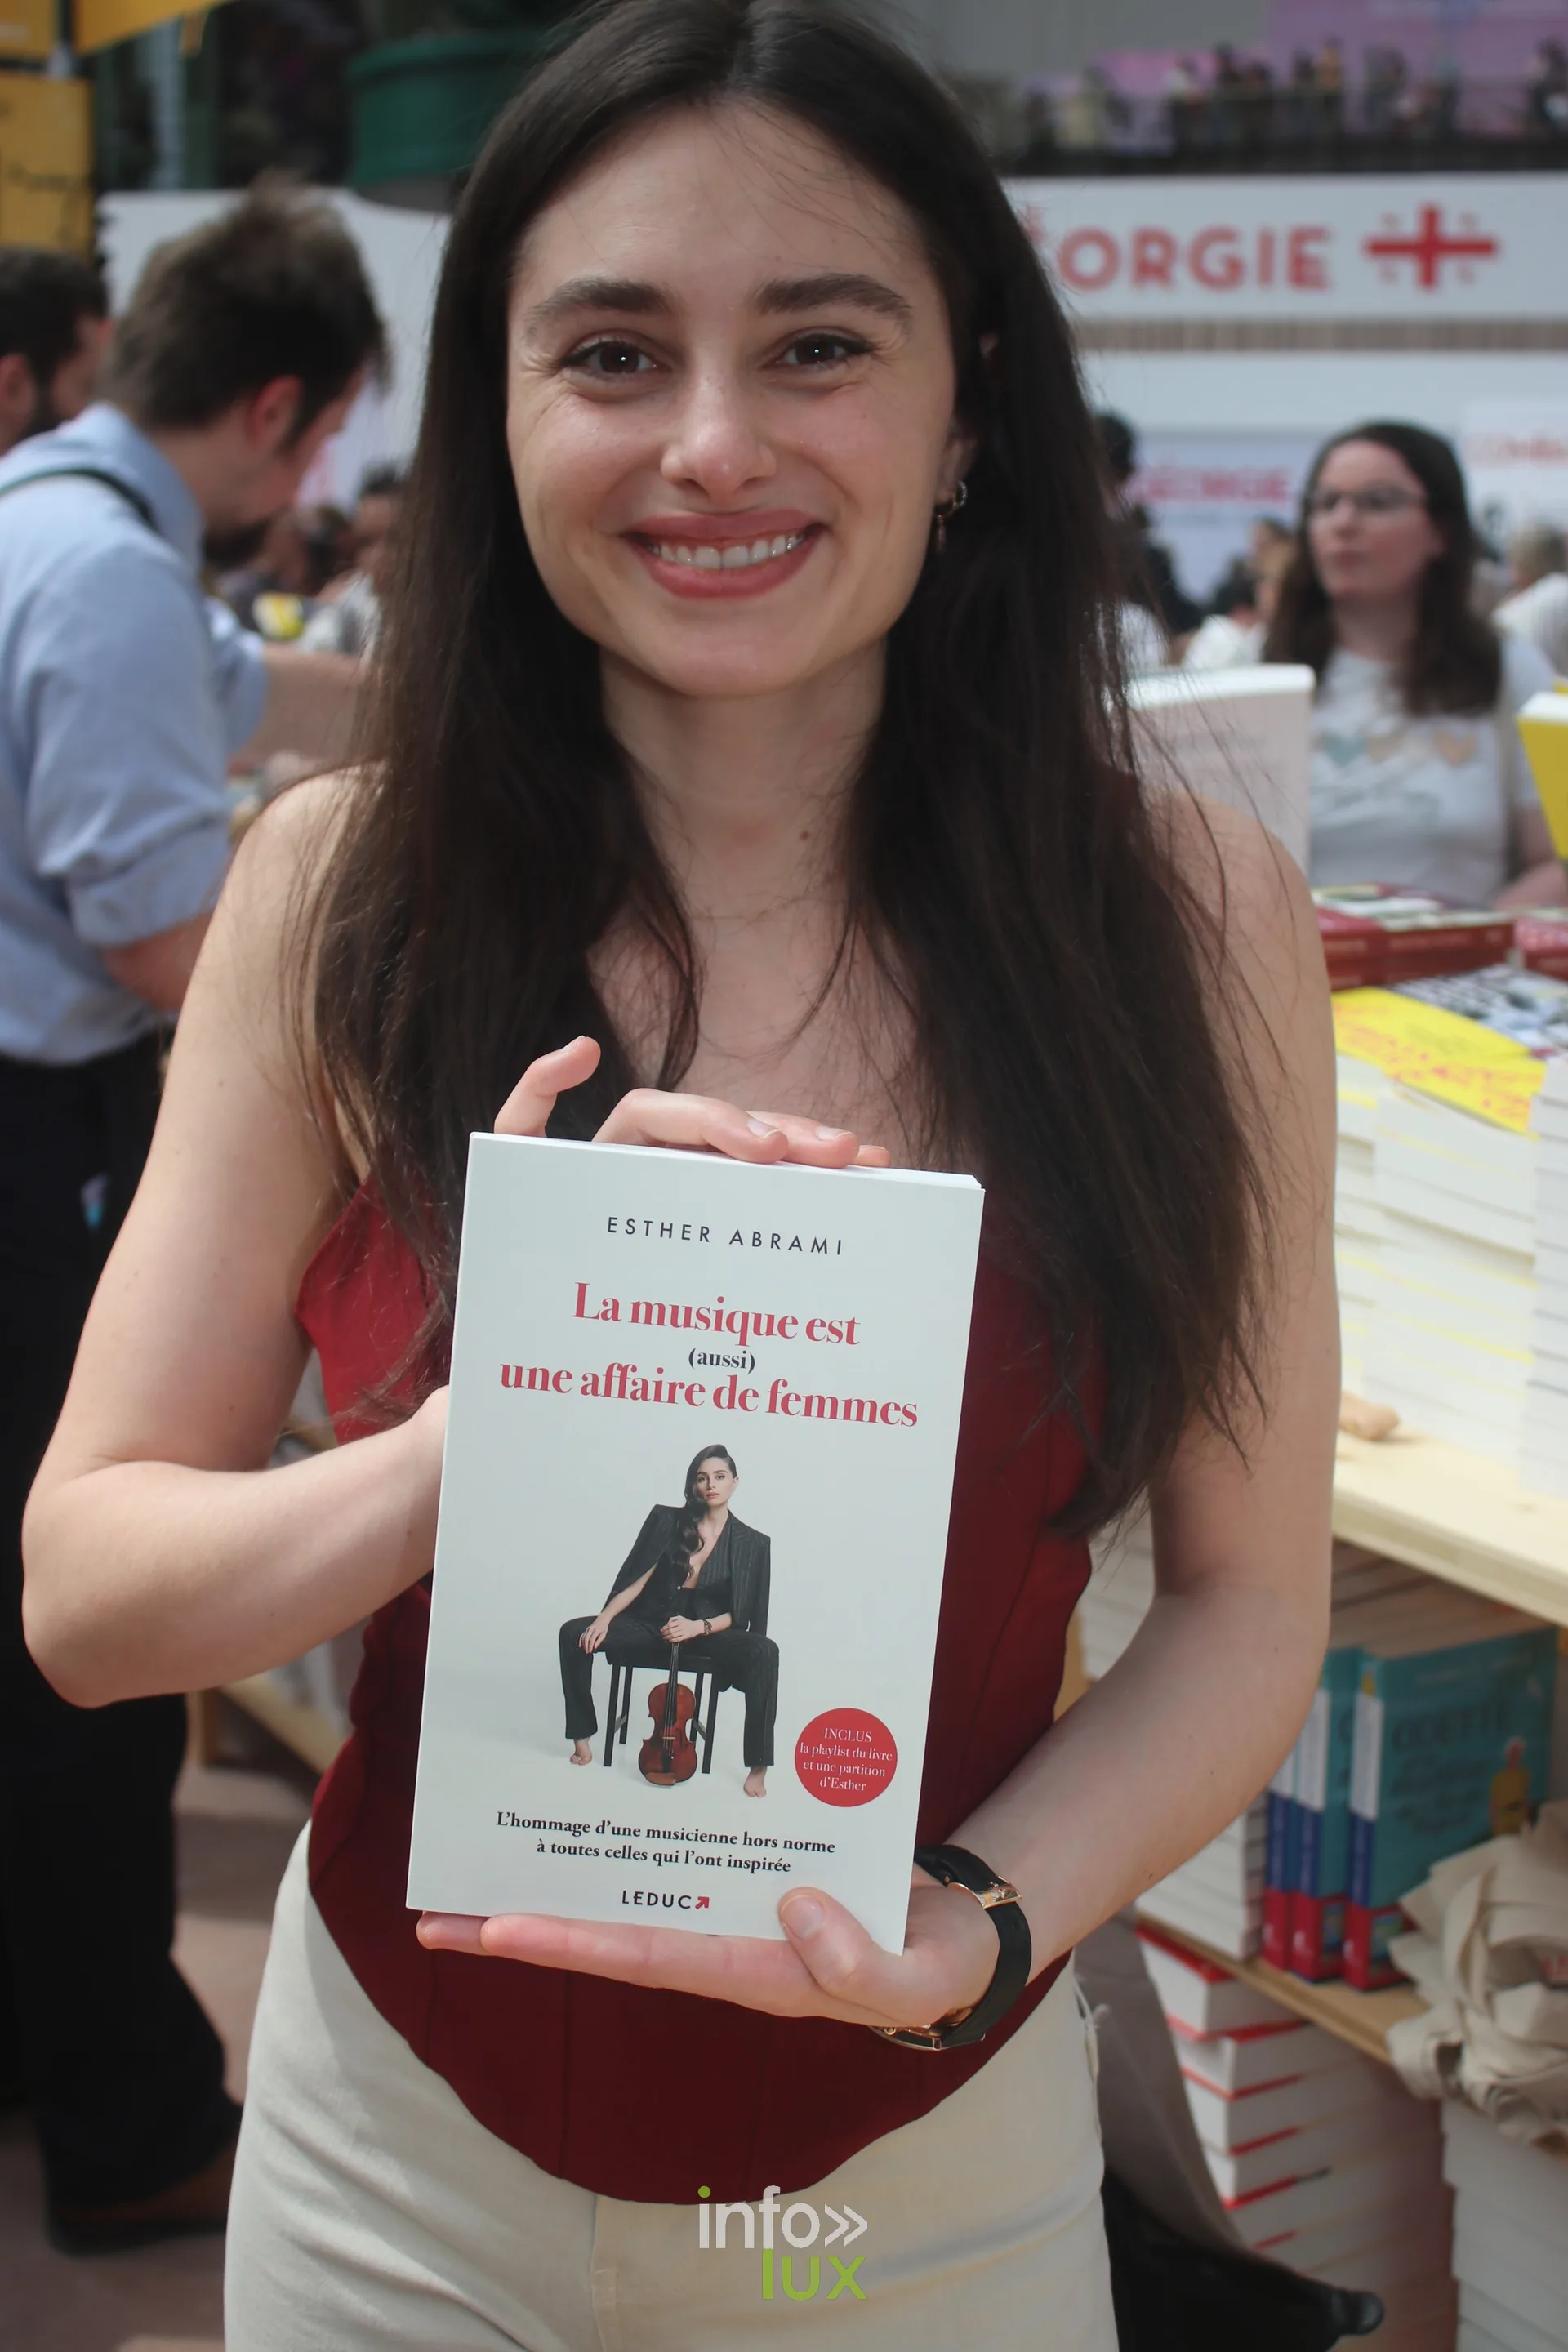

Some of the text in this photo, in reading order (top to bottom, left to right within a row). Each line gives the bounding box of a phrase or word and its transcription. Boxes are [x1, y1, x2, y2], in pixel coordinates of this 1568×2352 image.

[607, 1216, 843, 1256] ESTHER ABRAMI
[572, 1281, 861, 1347] La musique est
[688, 1347, 755, 1374] (aussi)
[499, 1361, 918, 1428] une affaire de femmes
[824, 1727, 872, 1742] INCLUS
[800, 1742, 893, 1761] la playlist du livre
[803, 1761, 885, 1776] et une partition
[820, 1777, 866, 1791] d’Esther
[496, 1811, 835, 1854] L’hommage d’une musicienne hors norme
[537, 1838, 791, 1874] à toutes celles qui l’ont inspirée
[621, 1891, 693, 1910] LEDUC
